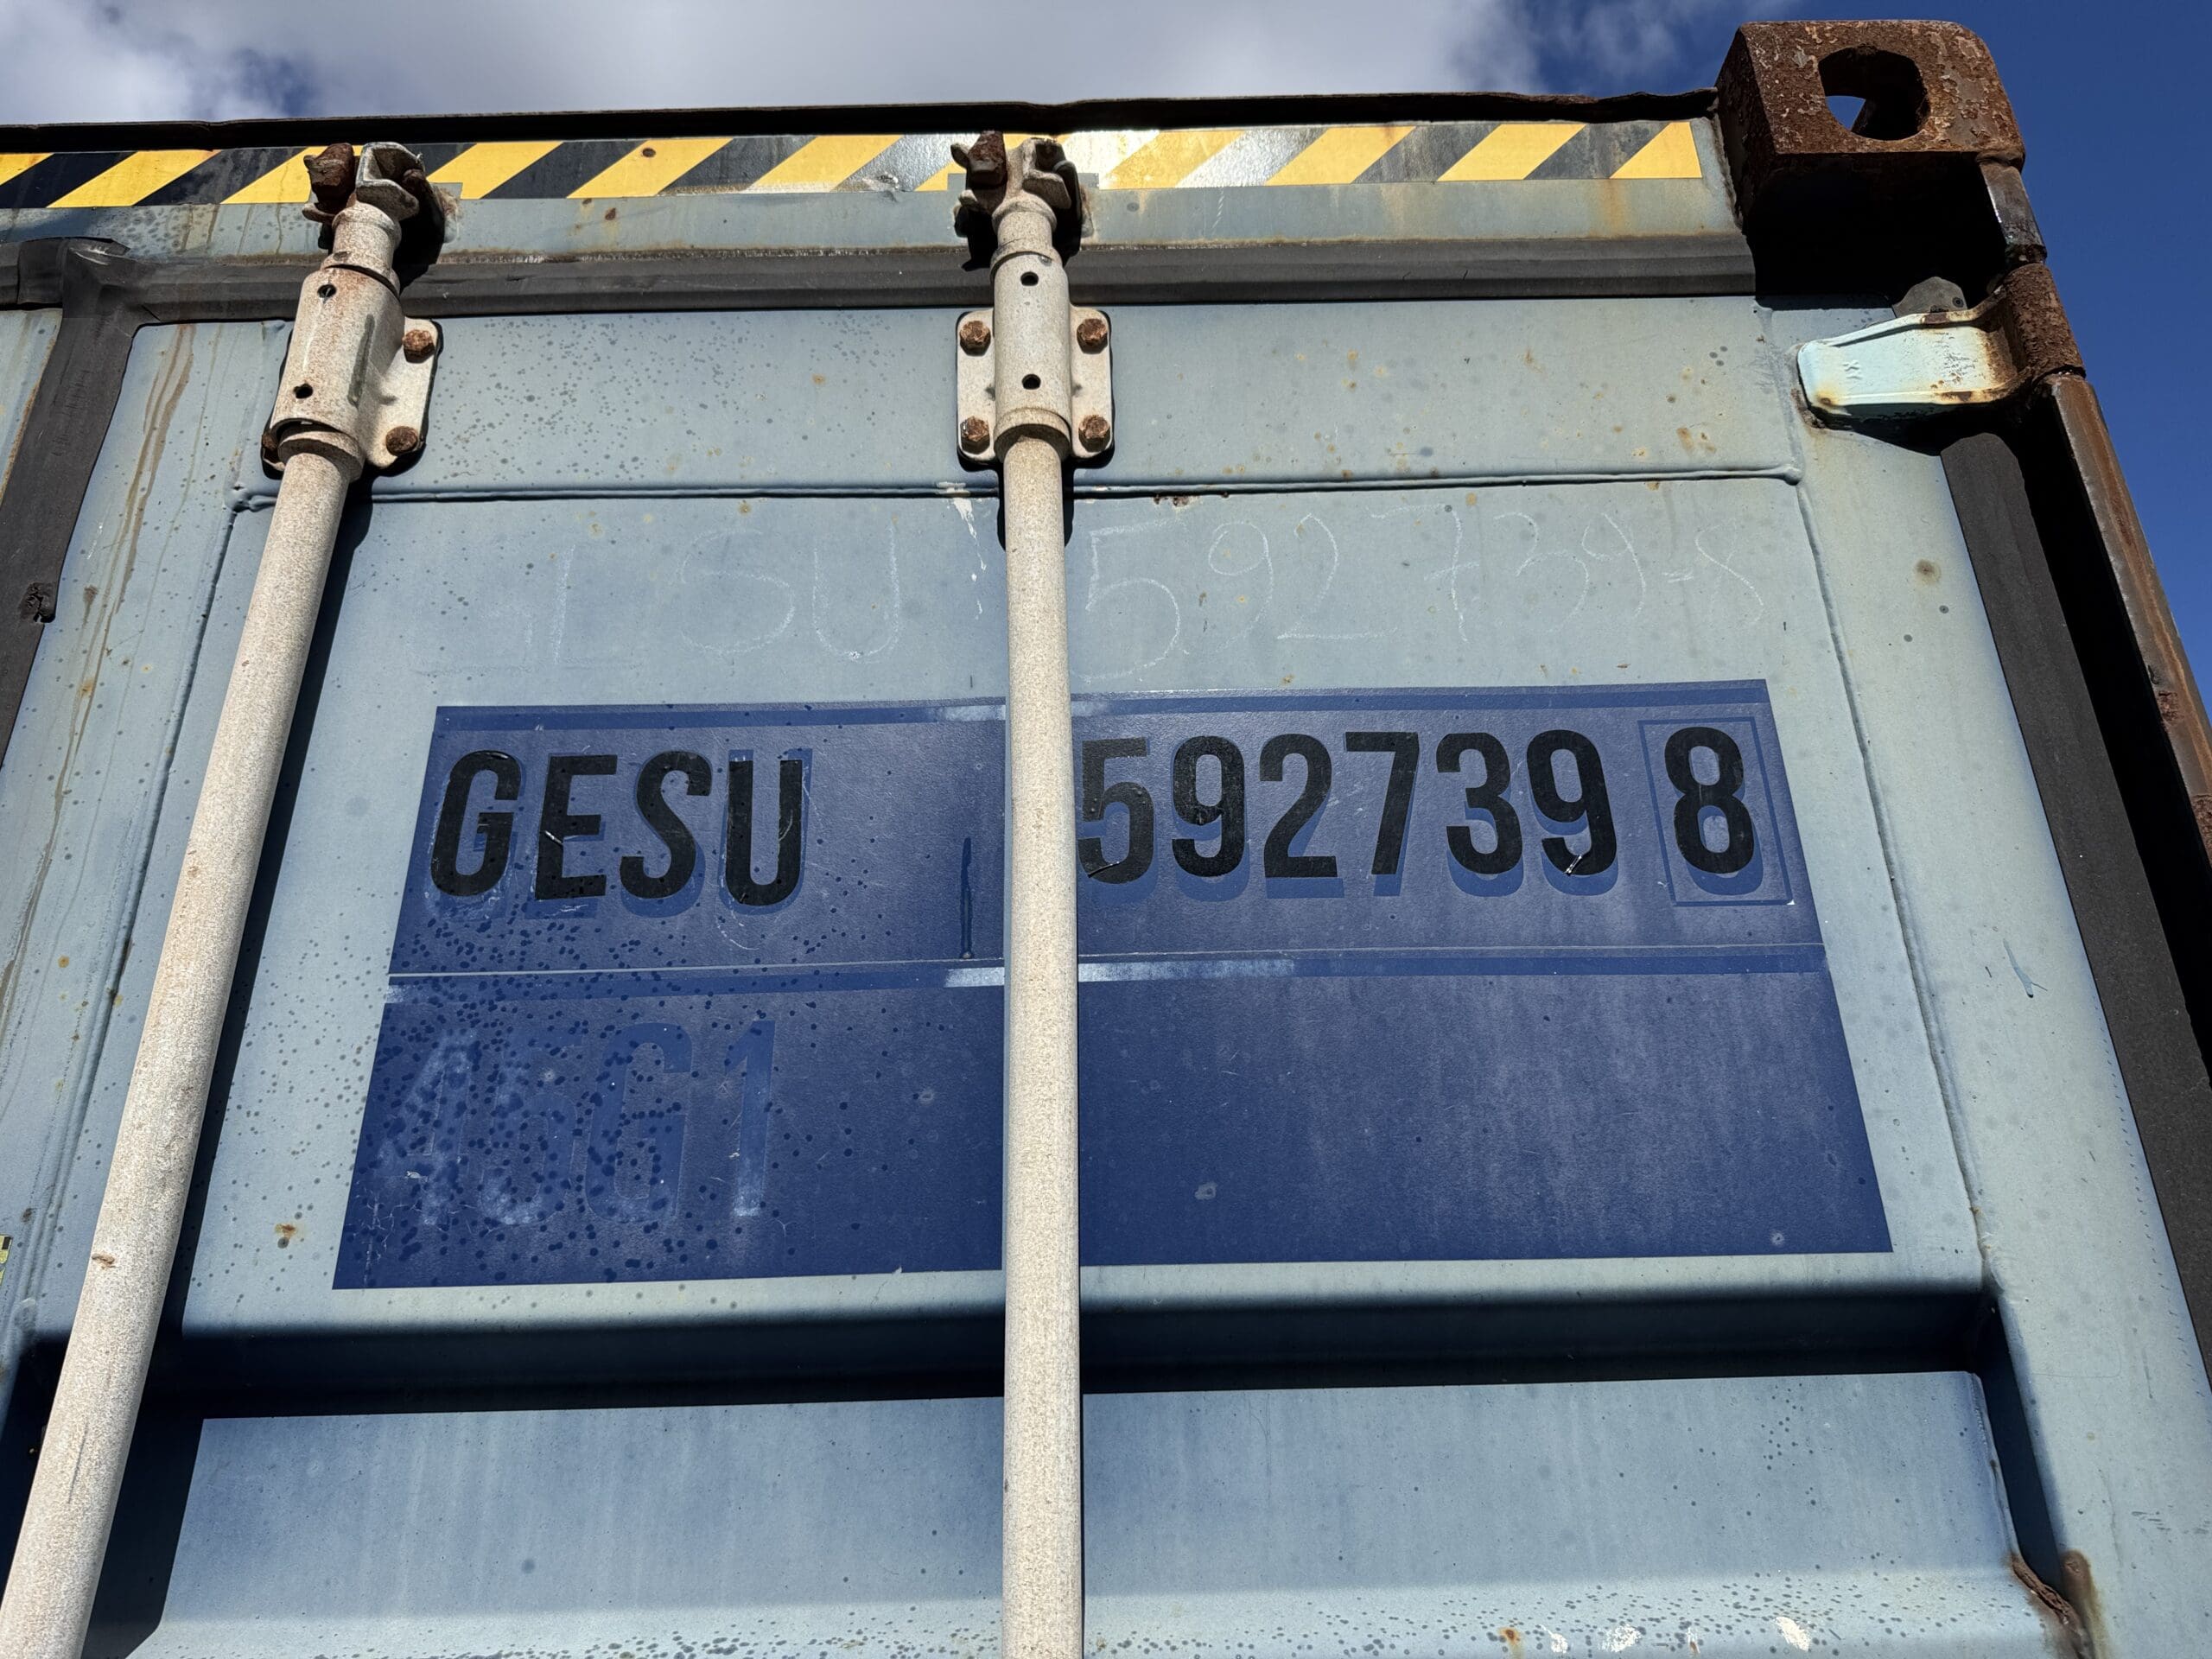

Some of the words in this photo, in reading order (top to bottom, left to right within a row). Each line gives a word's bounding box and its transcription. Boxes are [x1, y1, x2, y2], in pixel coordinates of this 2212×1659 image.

[430, 749, 804, 906] GESU
[1077, 728, 1617, 883] 592739
[1662, 726, 1755, 875] 8
